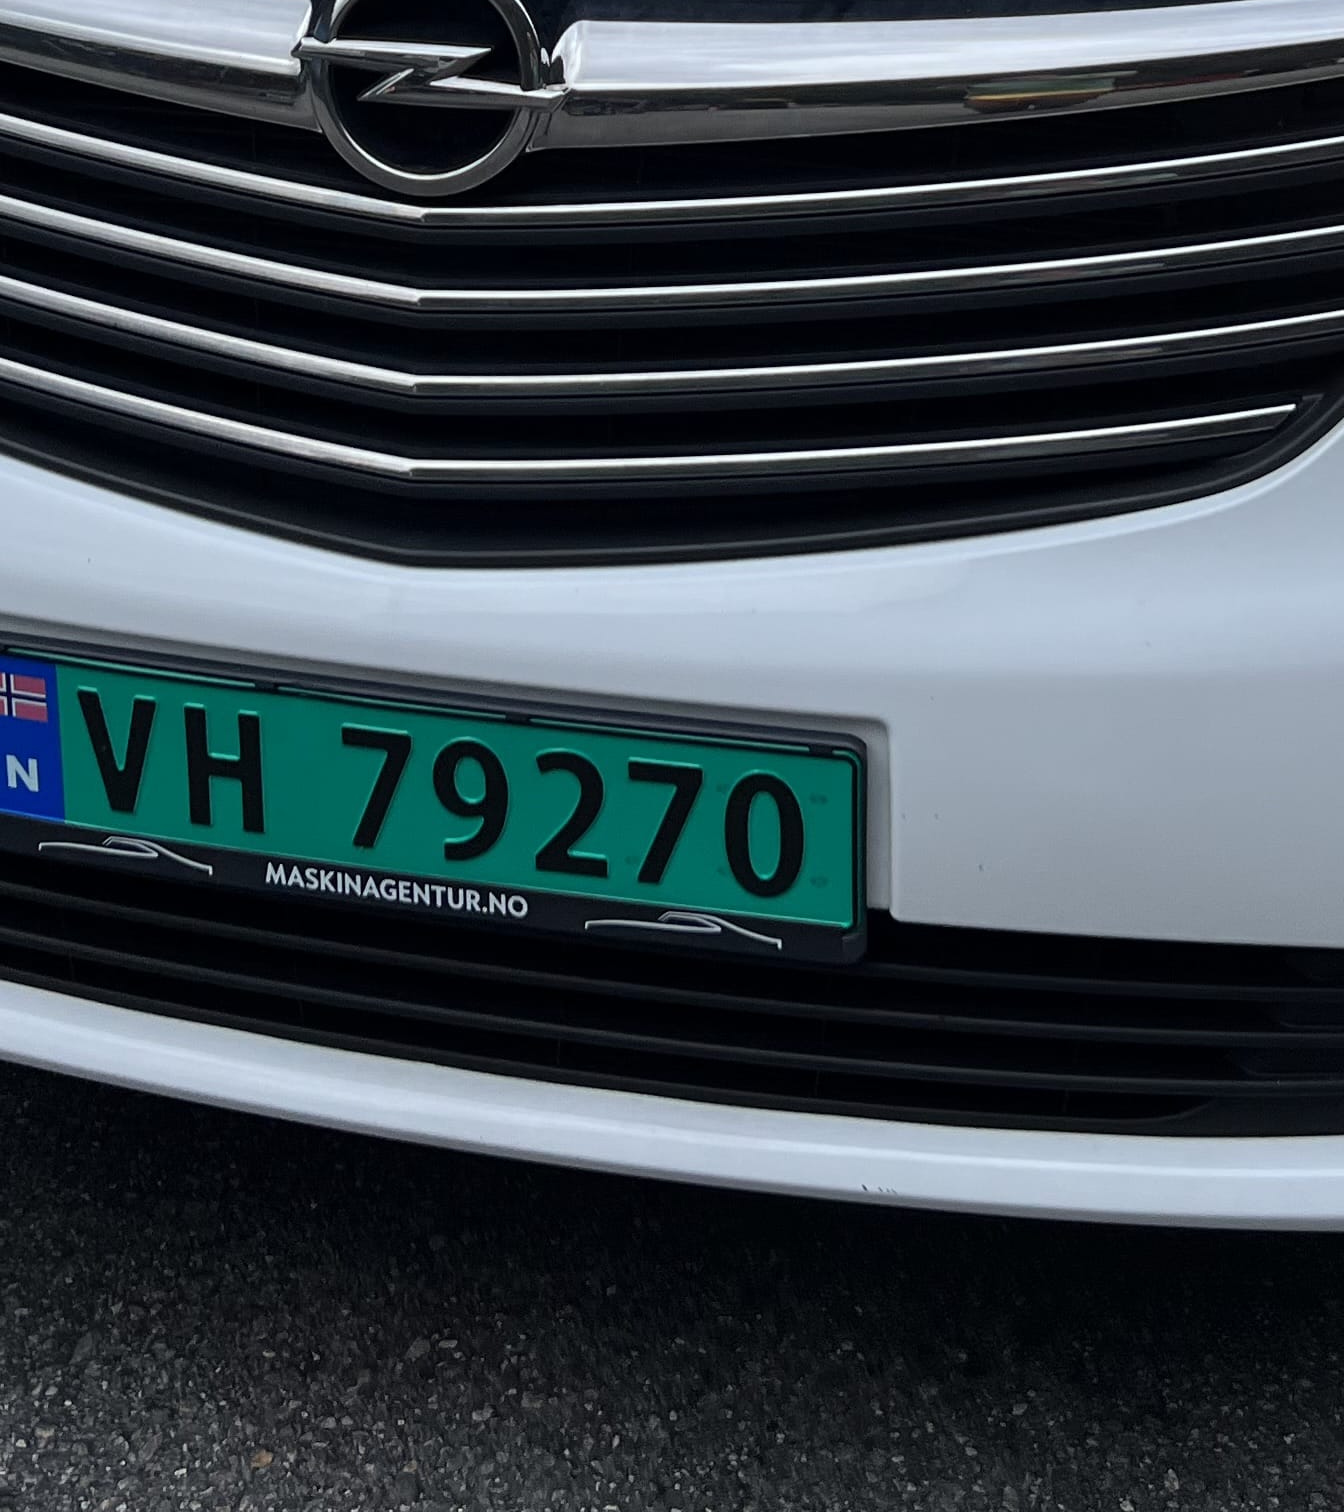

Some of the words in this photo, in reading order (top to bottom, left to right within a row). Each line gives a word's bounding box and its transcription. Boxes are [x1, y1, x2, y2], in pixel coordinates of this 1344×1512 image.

[6, 754, 39, 793] N
[77, 686, 265, 833] VH
[341, 722, 804, 898] 79270
[265, 861, 528, 918] MASKINAGENTUR.NO
